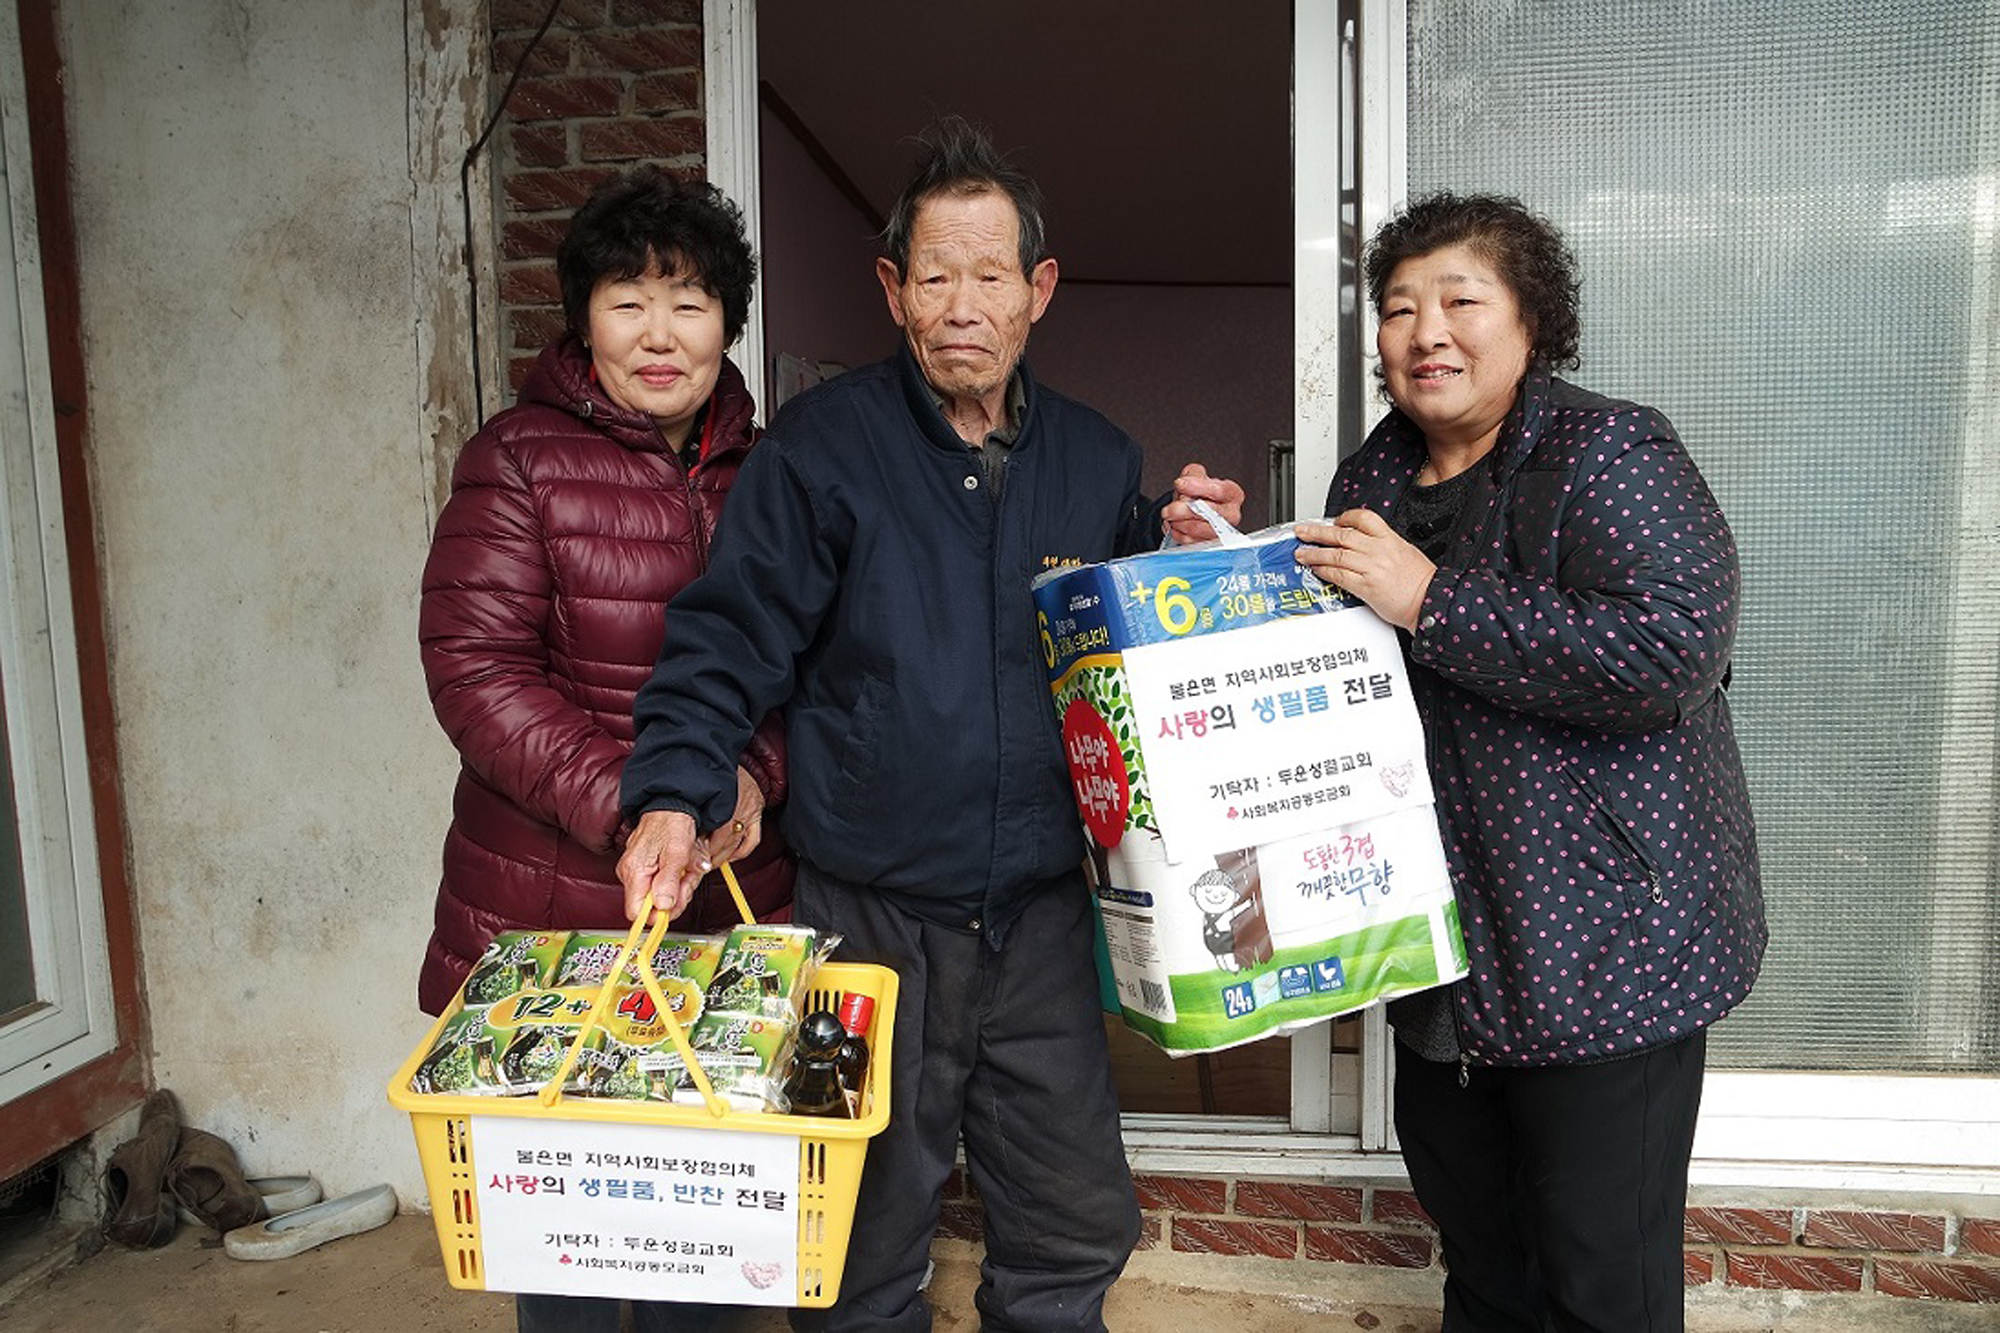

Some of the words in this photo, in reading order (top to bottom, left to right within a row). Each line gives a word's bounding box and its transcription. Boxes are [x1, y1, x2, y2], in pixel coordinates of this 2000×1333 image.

[1169, 676, 1217, 700] 불은면
[1225, 648, 1369, 688] 지역사회보장협의체
[1158, 704, 1236, 740] 사랑의
[1251, 685, 1329, 724] 생필품
[1343, 672, 1393, 705] 전달
[1070, 732, 1109, 772] 나무야
[1209, 777, 1259, 801] 기탁자
[1278, 752, 1373, 786] 두운성결교회
[1077, 774, 1120, 824] 나무야
[1242, 784, 1351, 820] 사회복지공동모금회
[1296, 870, 1347, 901] 깨끗한
[1344, 858, 1395, 906] 무향
[517, 1150, 572, 1167] 불은면
[585, 1152, 755, 1178] 지역사회보장협의체
[489, 1173, 565, 1196] 사랑의
[579, 1177, 664, 1203] 생필품,
[674, 1183, 724, 1206] 반찬
[736, 1188, 788, 1211] 전달
[545, 1233, 600, 1249] 기탁자
[624, 1237, 734, 1258] 두운성결교회
[575, 1256, 704, 1276] 사회복지공동모금회
